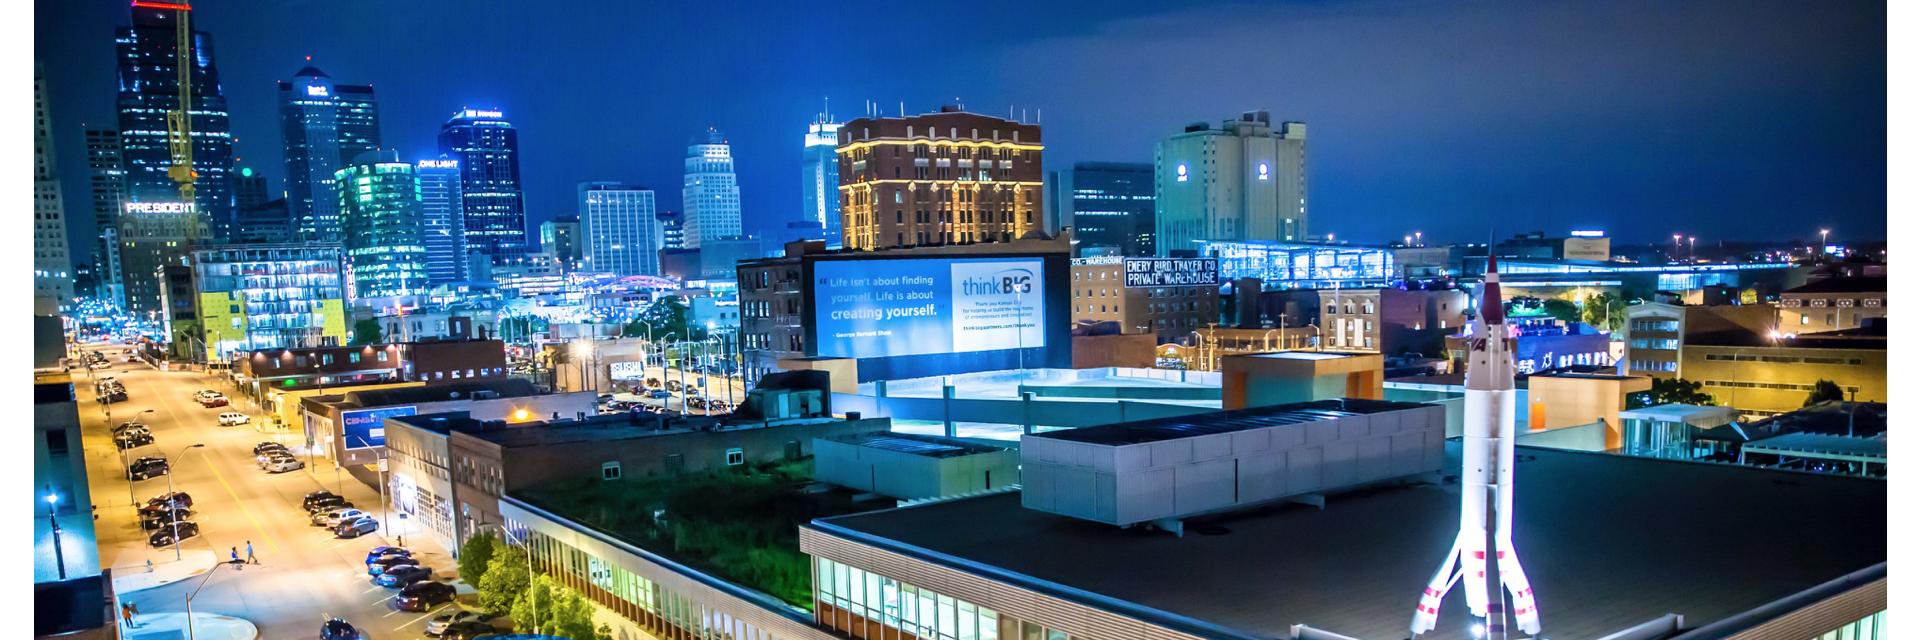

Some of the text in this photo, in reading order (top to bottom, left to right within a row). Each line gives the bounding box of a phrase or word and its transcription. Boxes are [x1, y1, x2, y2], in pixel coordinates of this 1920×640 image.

[126, 202, 195, 213] PRESIDENT
[1127, 261, 1151, 272] EMERY
[1174, 261, 1202, 271] THAYER
[873, 277, 899, 286] about
[902, 276, 933, 286] finding
[1128, 272, 1160, 285] PRIVATE
[876, 291, 893, 301] Life
[906, 289, 933, 300] about
[831, 304, 937, 320] creating yourself.
